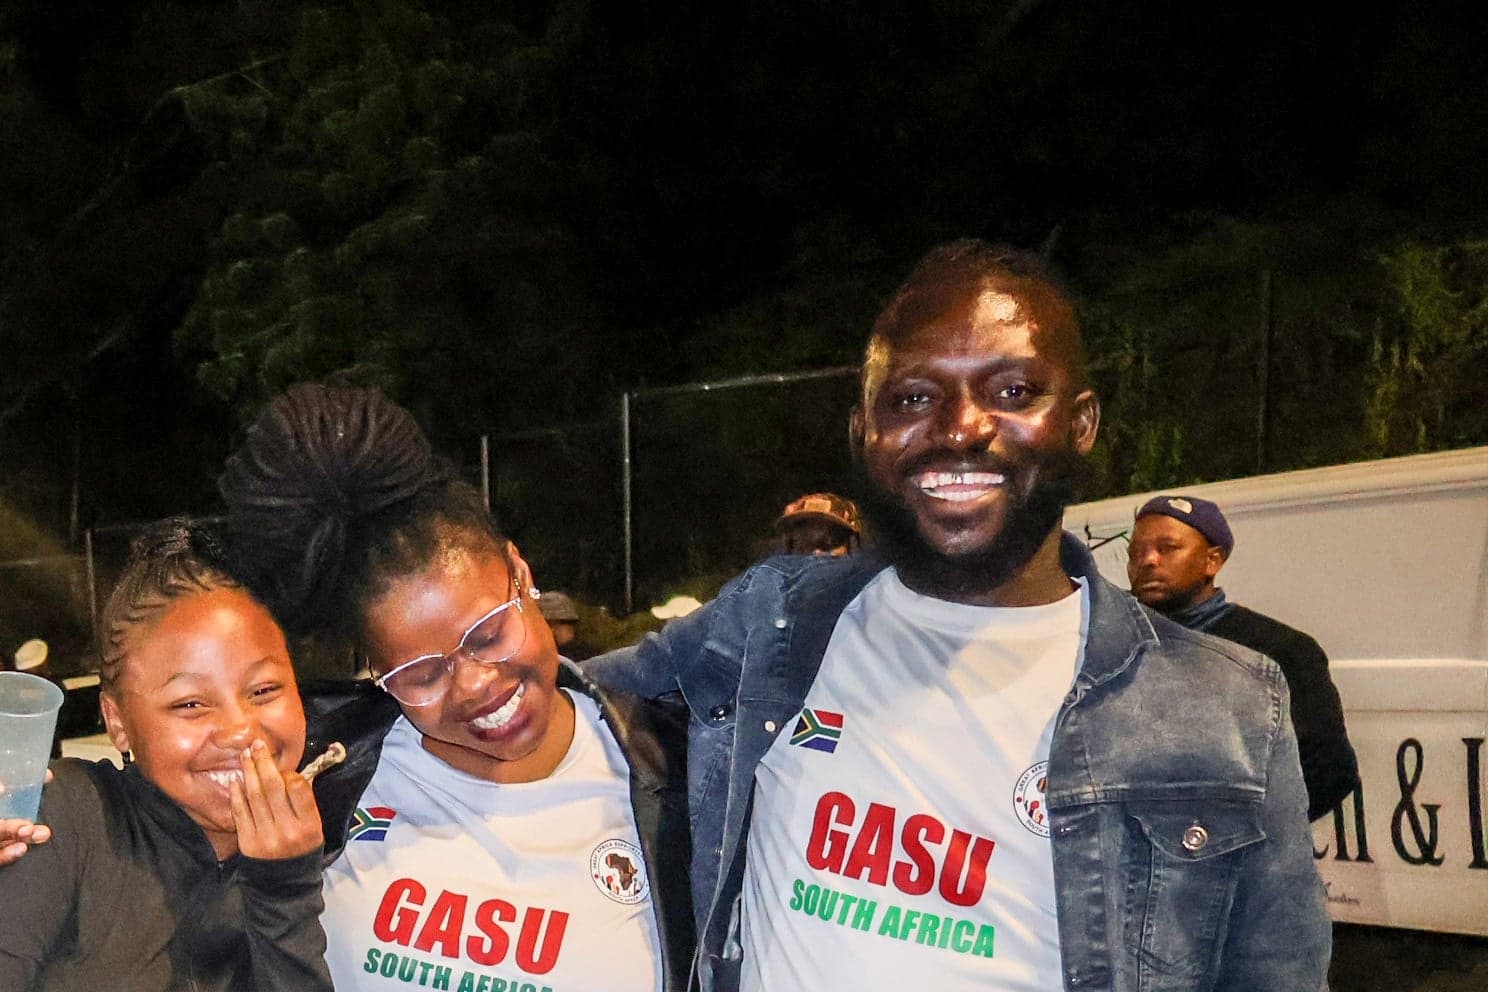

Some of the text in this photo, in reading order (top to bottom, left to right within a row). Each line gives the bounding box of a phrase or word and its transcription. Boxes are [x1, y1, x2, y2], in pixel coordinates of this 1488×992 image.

[806, 791, 995, 907] GASU
[1391, 737, 1445, 866] &
[373, 878, 569, 975] GASU
[789, 879, 996, 959] SOUTH AFRICA
[363, 948, 451, 991] SOUTH
